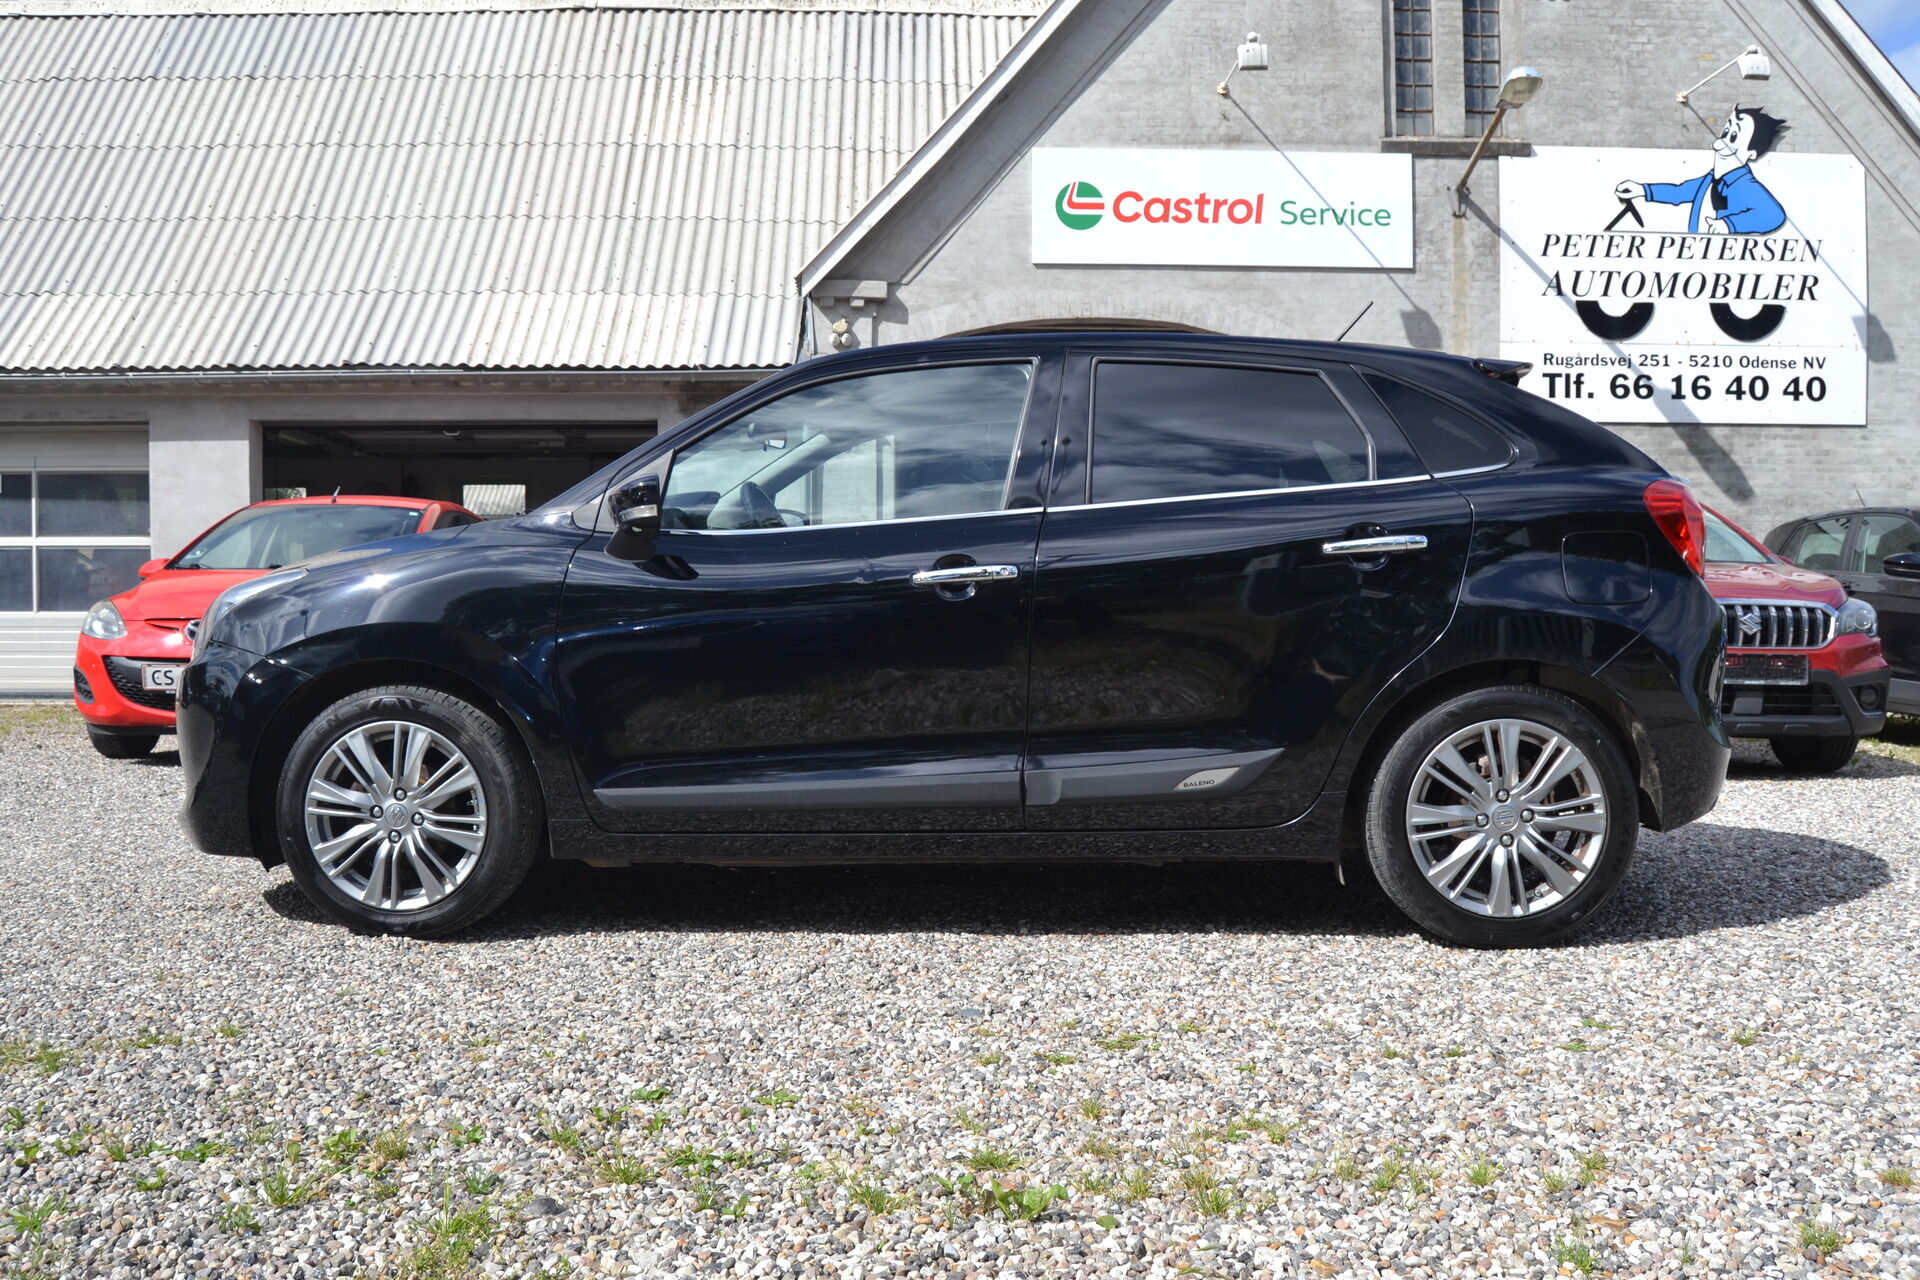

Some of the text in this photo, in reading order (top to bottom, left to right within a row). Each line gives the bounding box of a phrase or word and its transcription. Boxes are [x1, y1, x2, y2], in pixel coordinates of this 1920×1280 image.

[1112, 190, 1391, 227] Castrol Service
[1540, 233, 1823, 262] PETER PETERSEN
[1541, 269, 1819, 301] AUTOMOBILER
[1638, 354, 1670, 367] 251
[1689, 355, 1733, 368] 5210
[1739, 355, 1797, 369] Odense
[1803, 356, 1827, 369] NV
[1542, 372, 1827, 402] Tlf. 66 16 40 40
[151, 669, 175, 686] CS
[1183, 779, 1215, 788] BALENO
